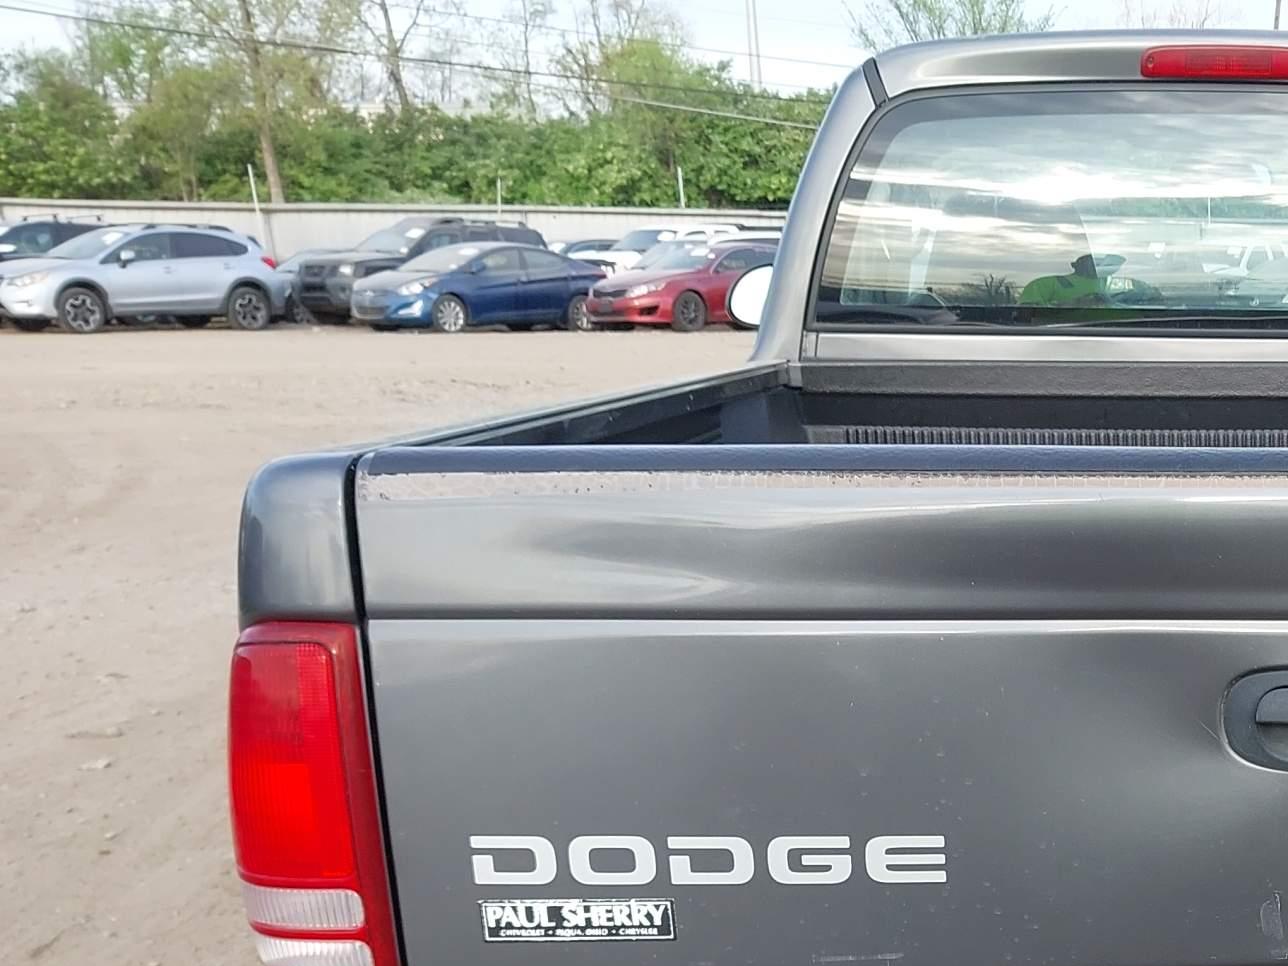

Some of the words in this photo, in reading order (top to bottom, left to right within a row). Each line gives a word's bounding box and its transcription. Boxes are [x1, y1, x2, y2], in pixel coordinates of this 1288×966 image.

[469, 835, 948, 886] DODGE
[486, 904, 556, 929] PAUL
[560, 903, 666, 928] SHERRY
